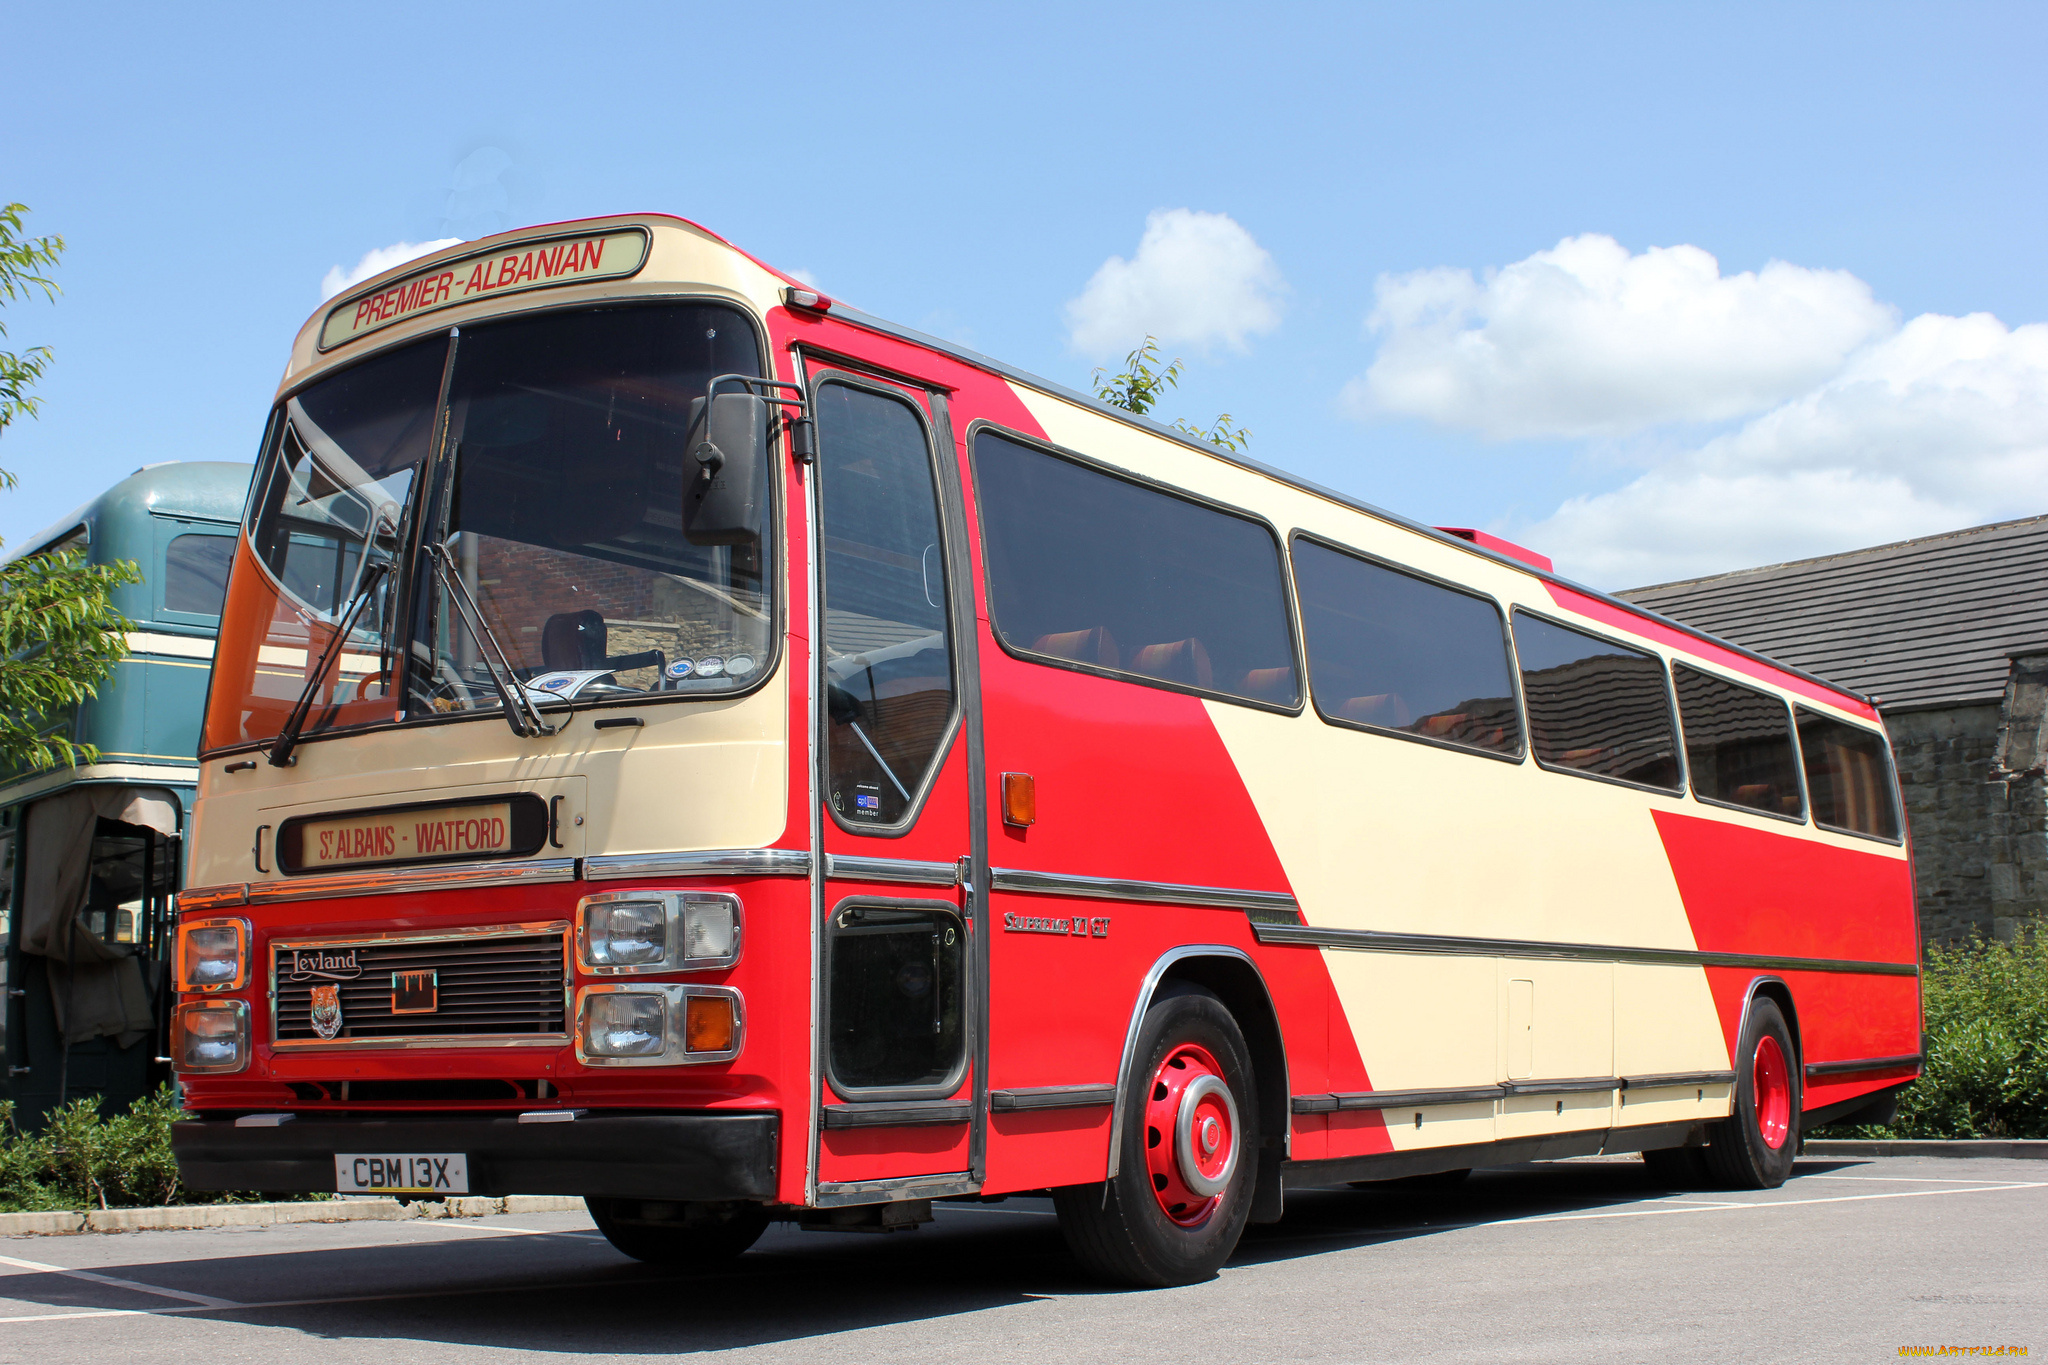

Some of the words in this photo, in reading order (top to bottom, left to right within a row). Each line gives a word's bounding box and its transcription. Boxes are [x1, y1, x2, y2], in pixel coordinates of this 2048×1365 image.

[353, 238, 606, 331] PREMIER-ALBANIAN
[856, 809, 879, 817] member
[335, 825, 395, 860] ALBANS
[415, 817, 505, 854] WATFORD
[1090, 917, 1111, 937] GT
[290, 950, 362, 981] Leyland
[353, 1157, 403, 1188] CBM
[408, 1157, 451, 1188] 13X
